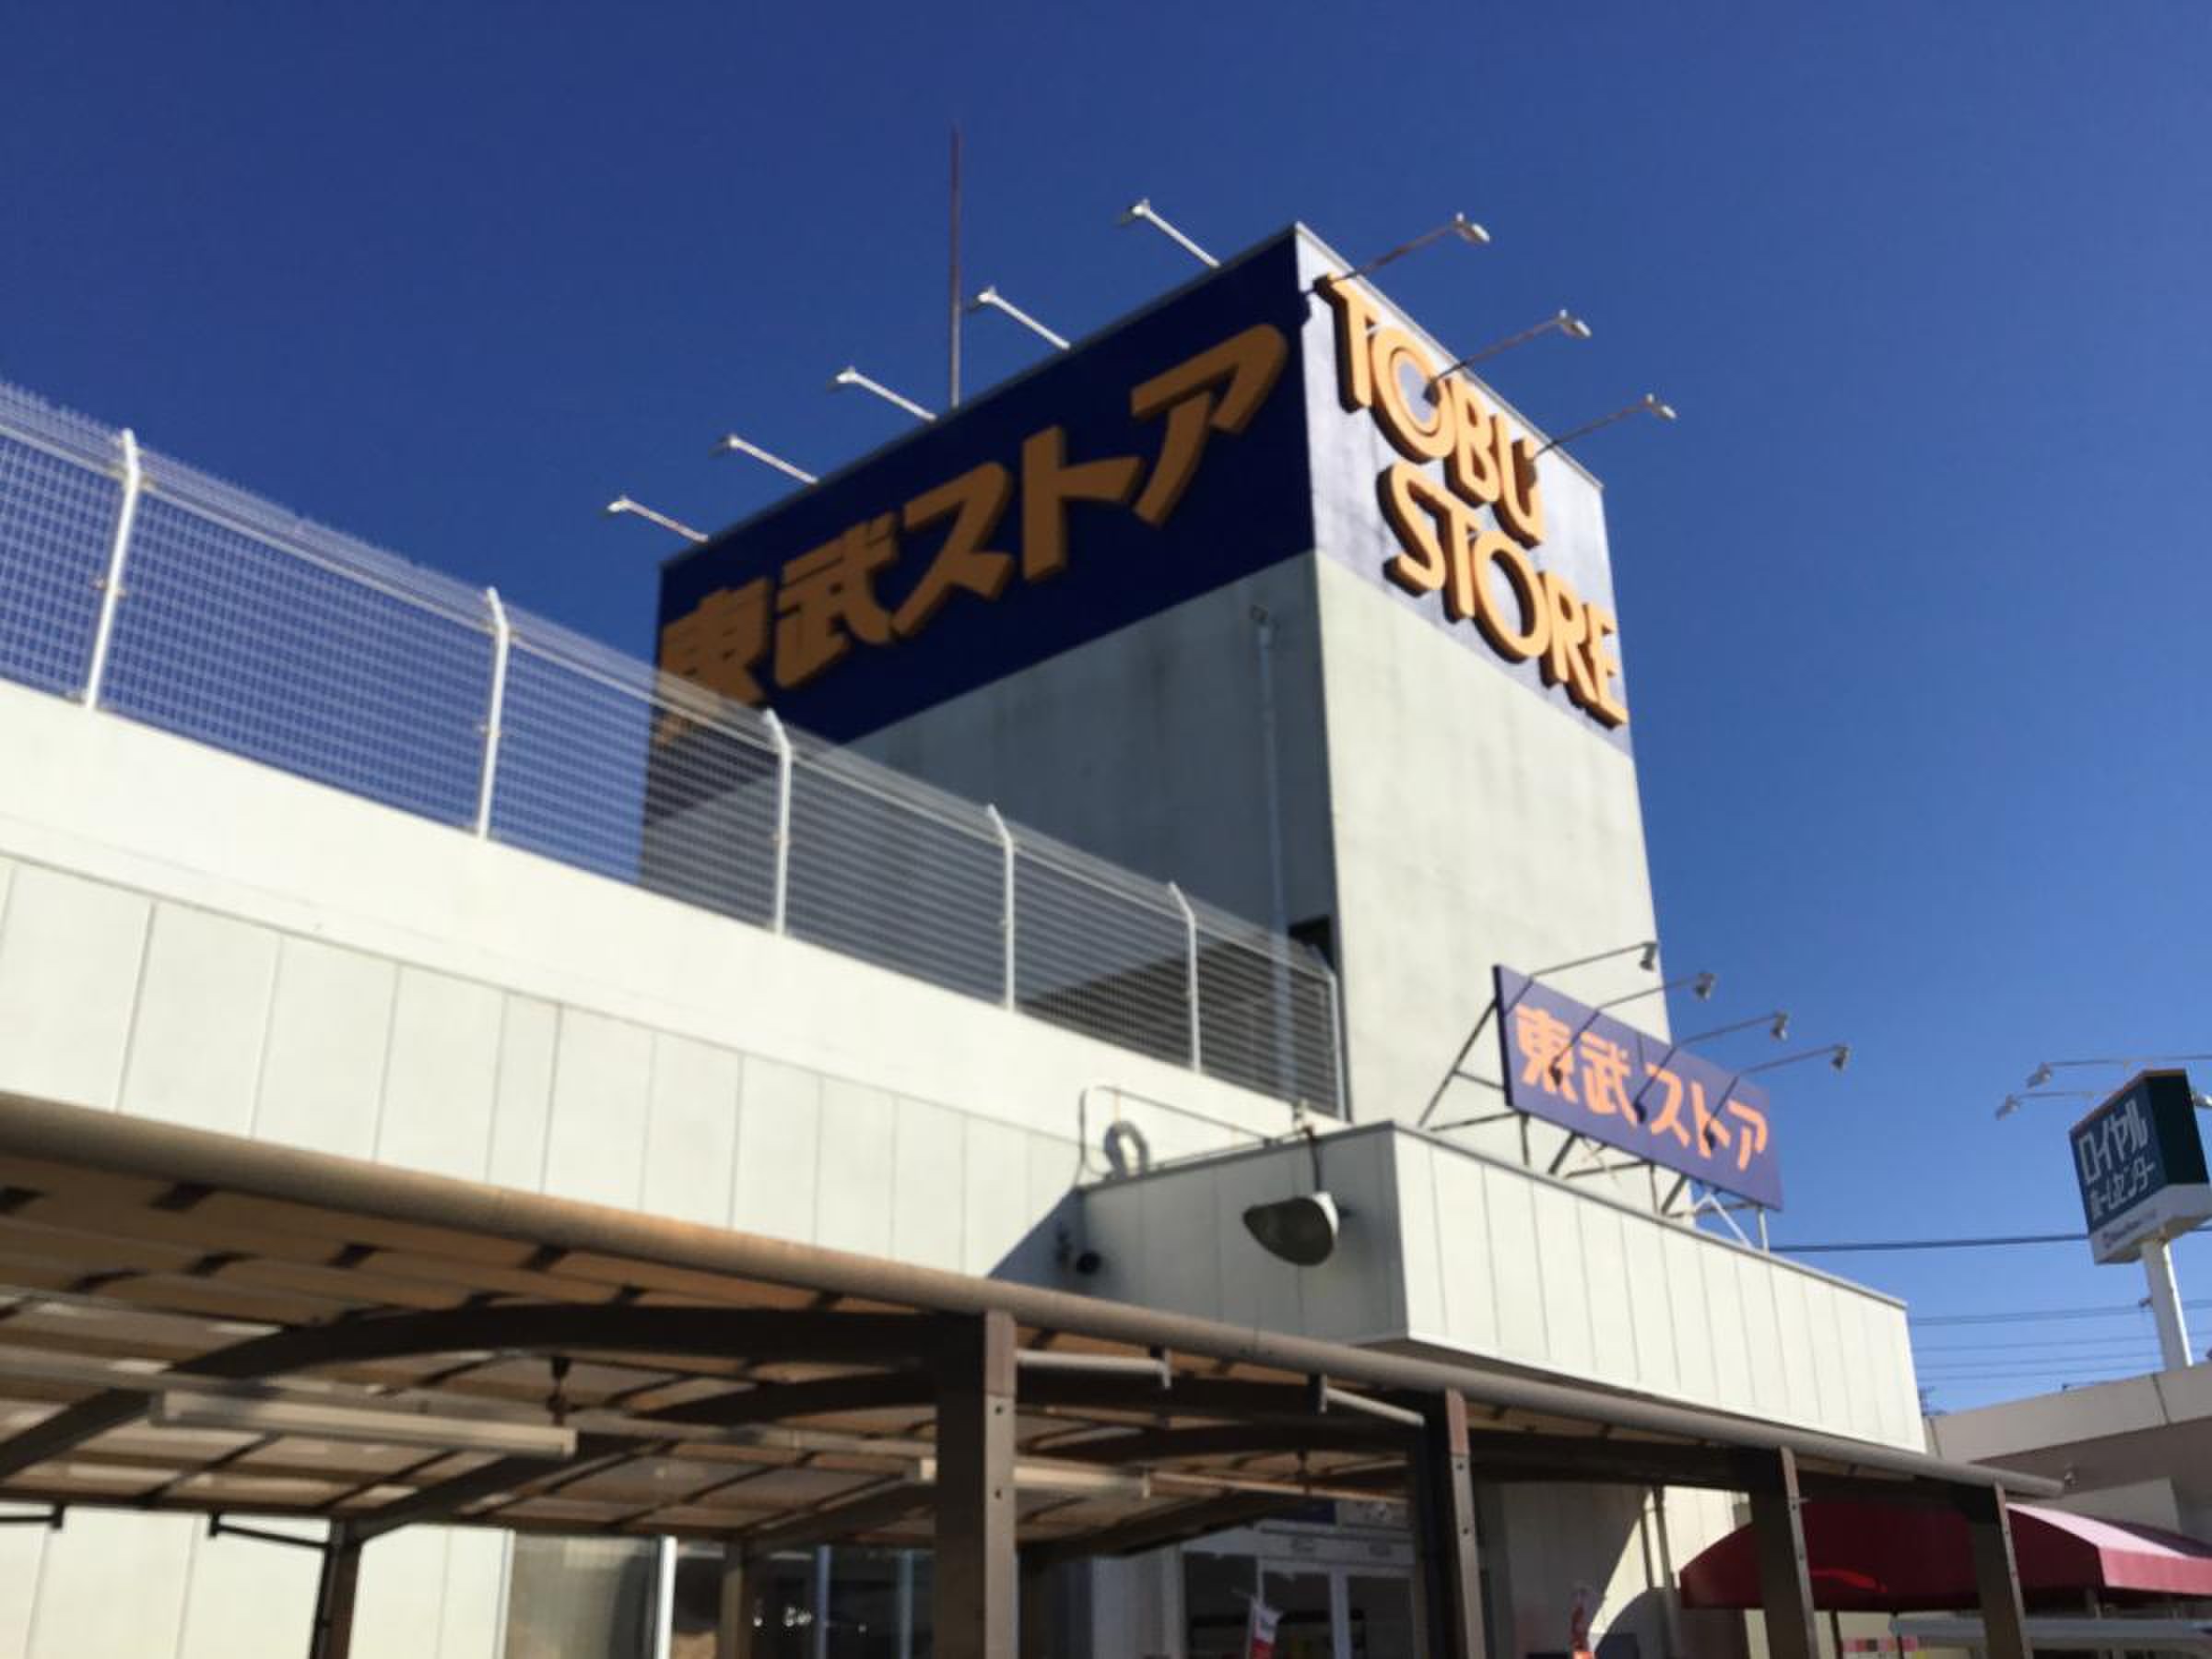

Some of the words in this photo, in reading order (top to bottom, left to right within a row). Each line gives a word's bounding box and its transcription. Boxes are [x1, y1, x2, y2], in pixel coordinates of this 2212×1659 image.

[653, 323, 1288, 748] 東武ストア
[1315, 273, 1546, 547] TOBU
[1377, 460, 1630, 728] STORE
[1514, 1002, 1768, 1171] 東武ストア
[2078, 1099, 2148, 1186] ロイヤル
